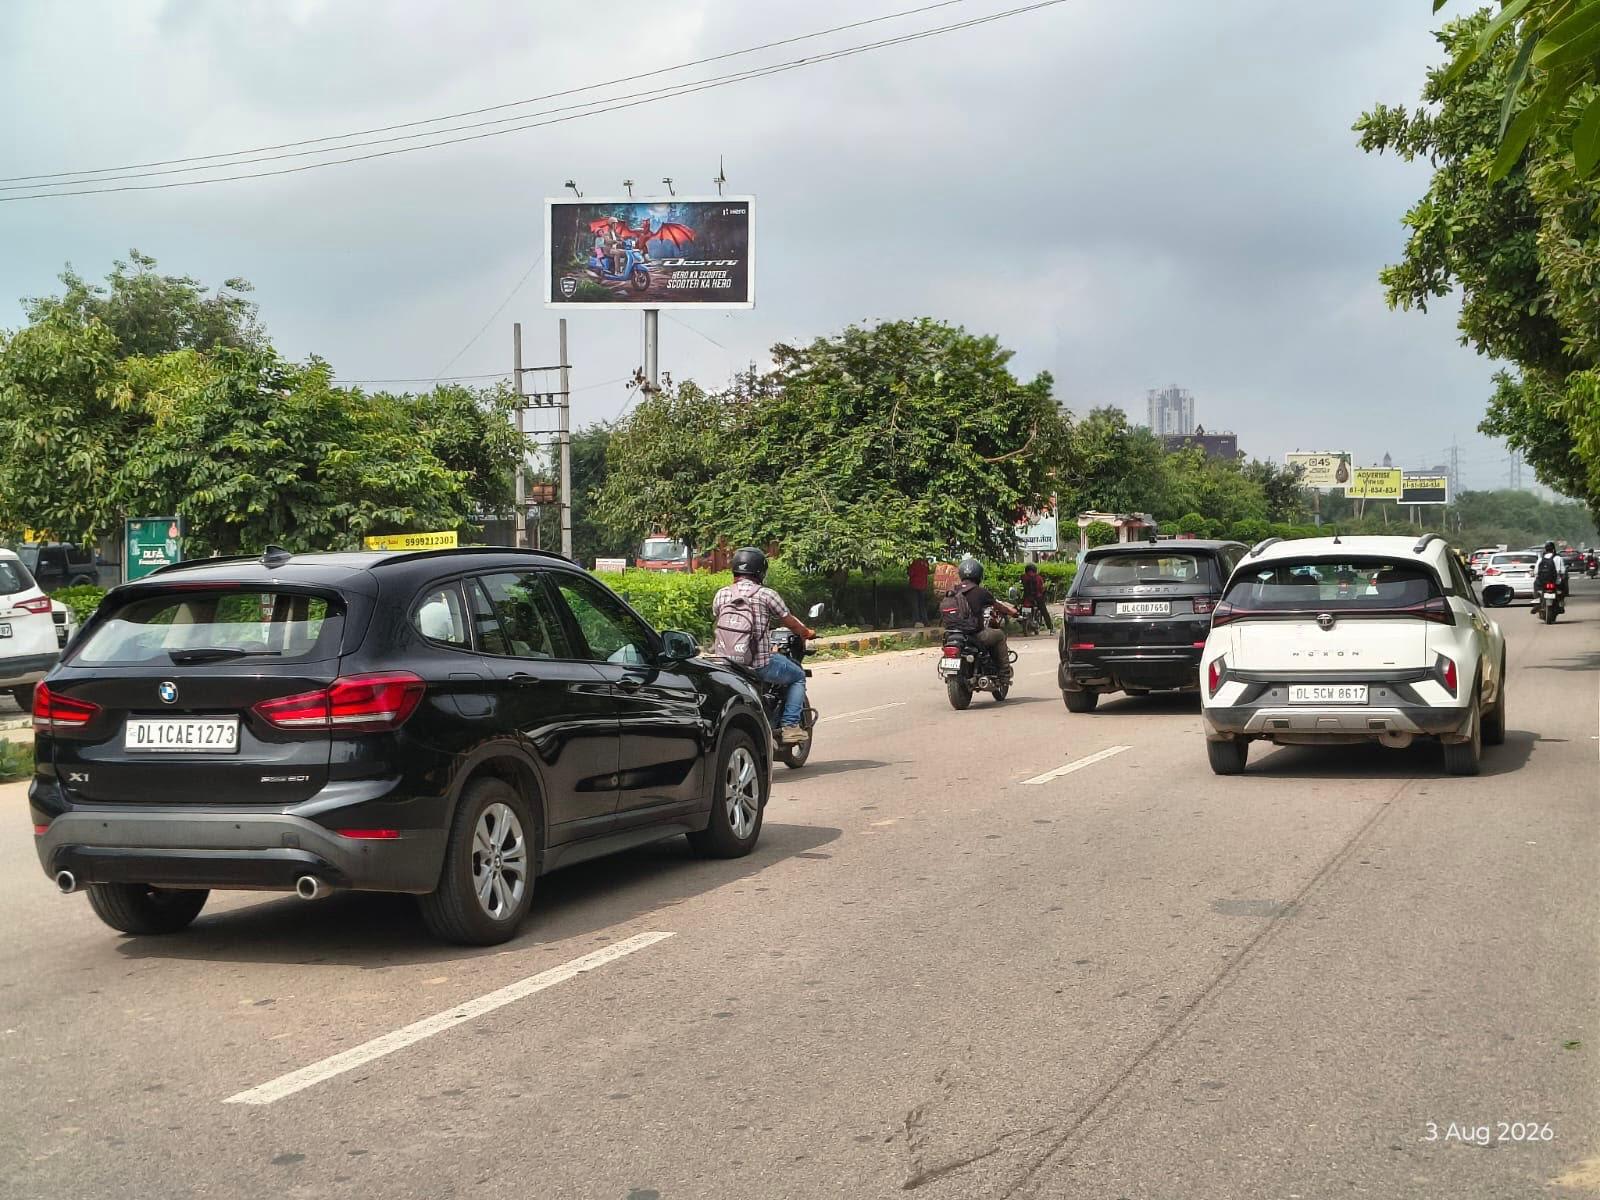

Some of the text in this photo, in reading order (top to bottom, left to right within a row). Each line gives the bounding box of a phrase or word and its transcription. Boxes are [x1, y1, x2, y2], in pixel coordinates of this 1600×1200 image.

[671, 271, 727, 279] HERO KA SCOOTER
[666, 279, 732, 289] SCOOTER KA HERO
[405, 535, 454, 547] 9999212303
[1106, 586, 1179, 594] DSCOVERY
[1296, 688, 1310, 699] DL
[1338, 687, 1366, 698] 8617
[137, 725, 235, 743] DL1CAE1273
[68, 772, 89, 782] X1
